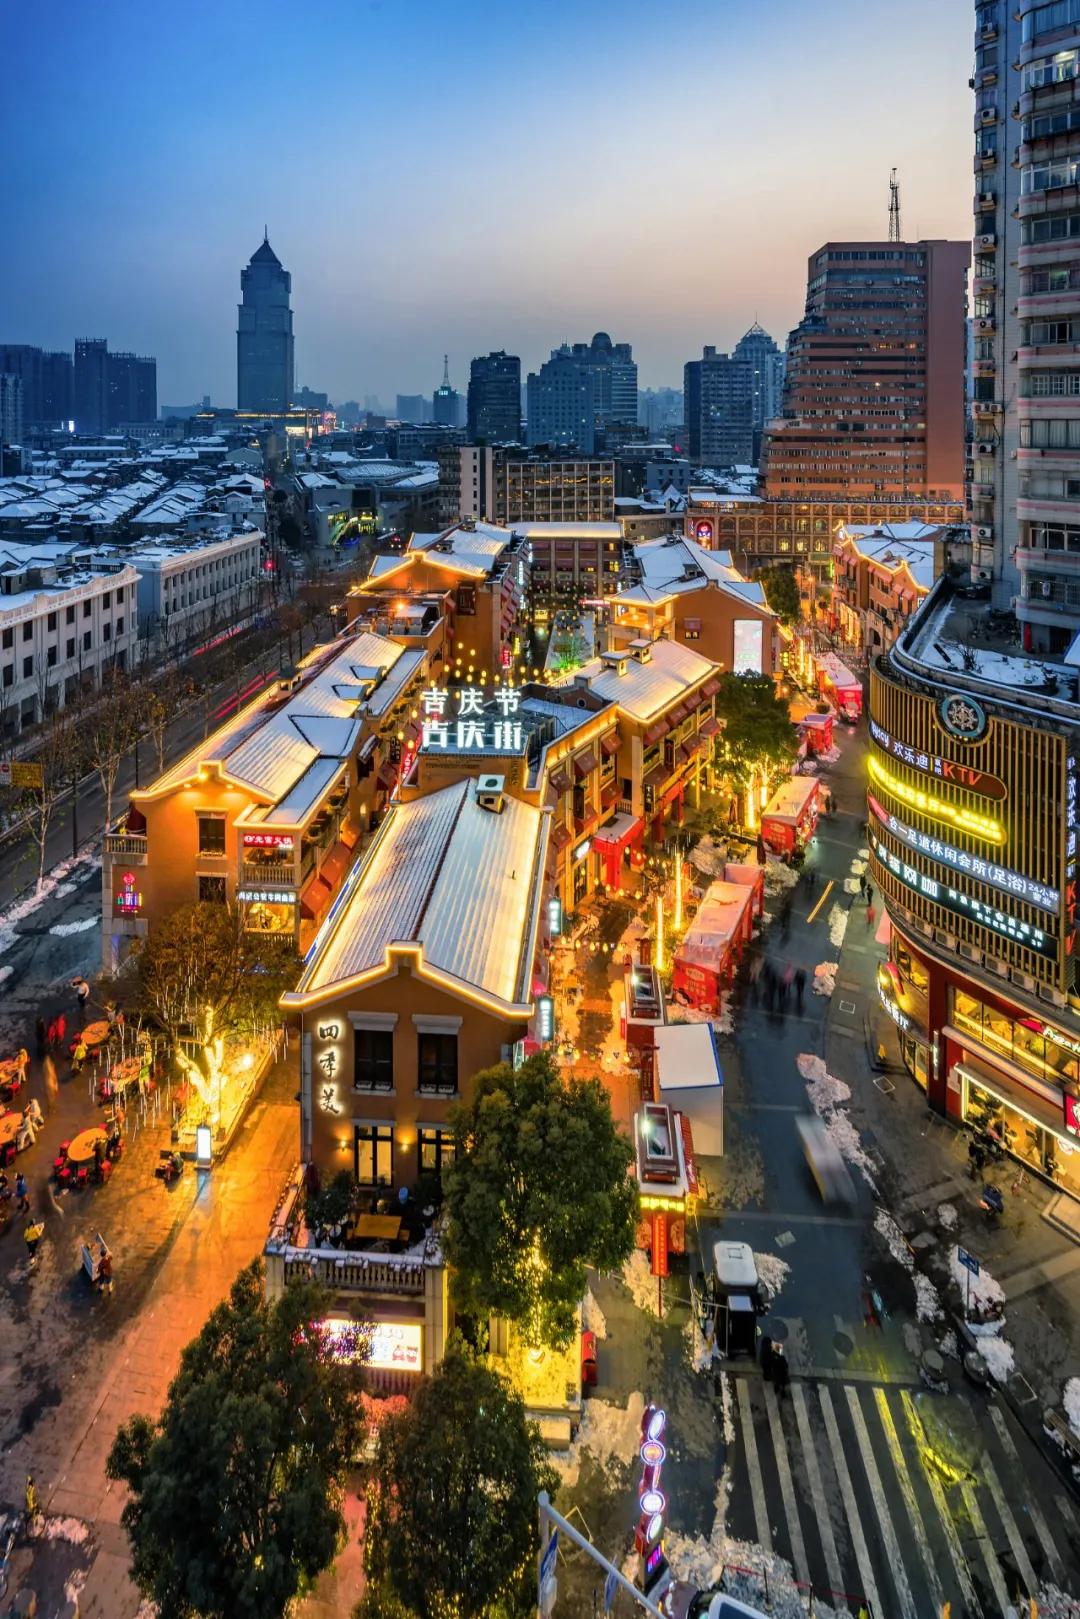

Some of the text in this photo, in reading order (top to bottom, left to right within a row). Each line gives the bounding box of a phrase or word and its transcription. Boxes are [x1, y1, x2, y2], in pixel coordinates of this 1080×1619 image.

[421, 687, 521, 716] 吉庆节
[421, 720, 521, 750] 吉庆街
[893, 740, 929, 770] 欢乐迪
[943, 762, 982, 786] KTV
[1065, 880, 1077, 957] KTV
[319, 1024, 340, 1114] 四季美
